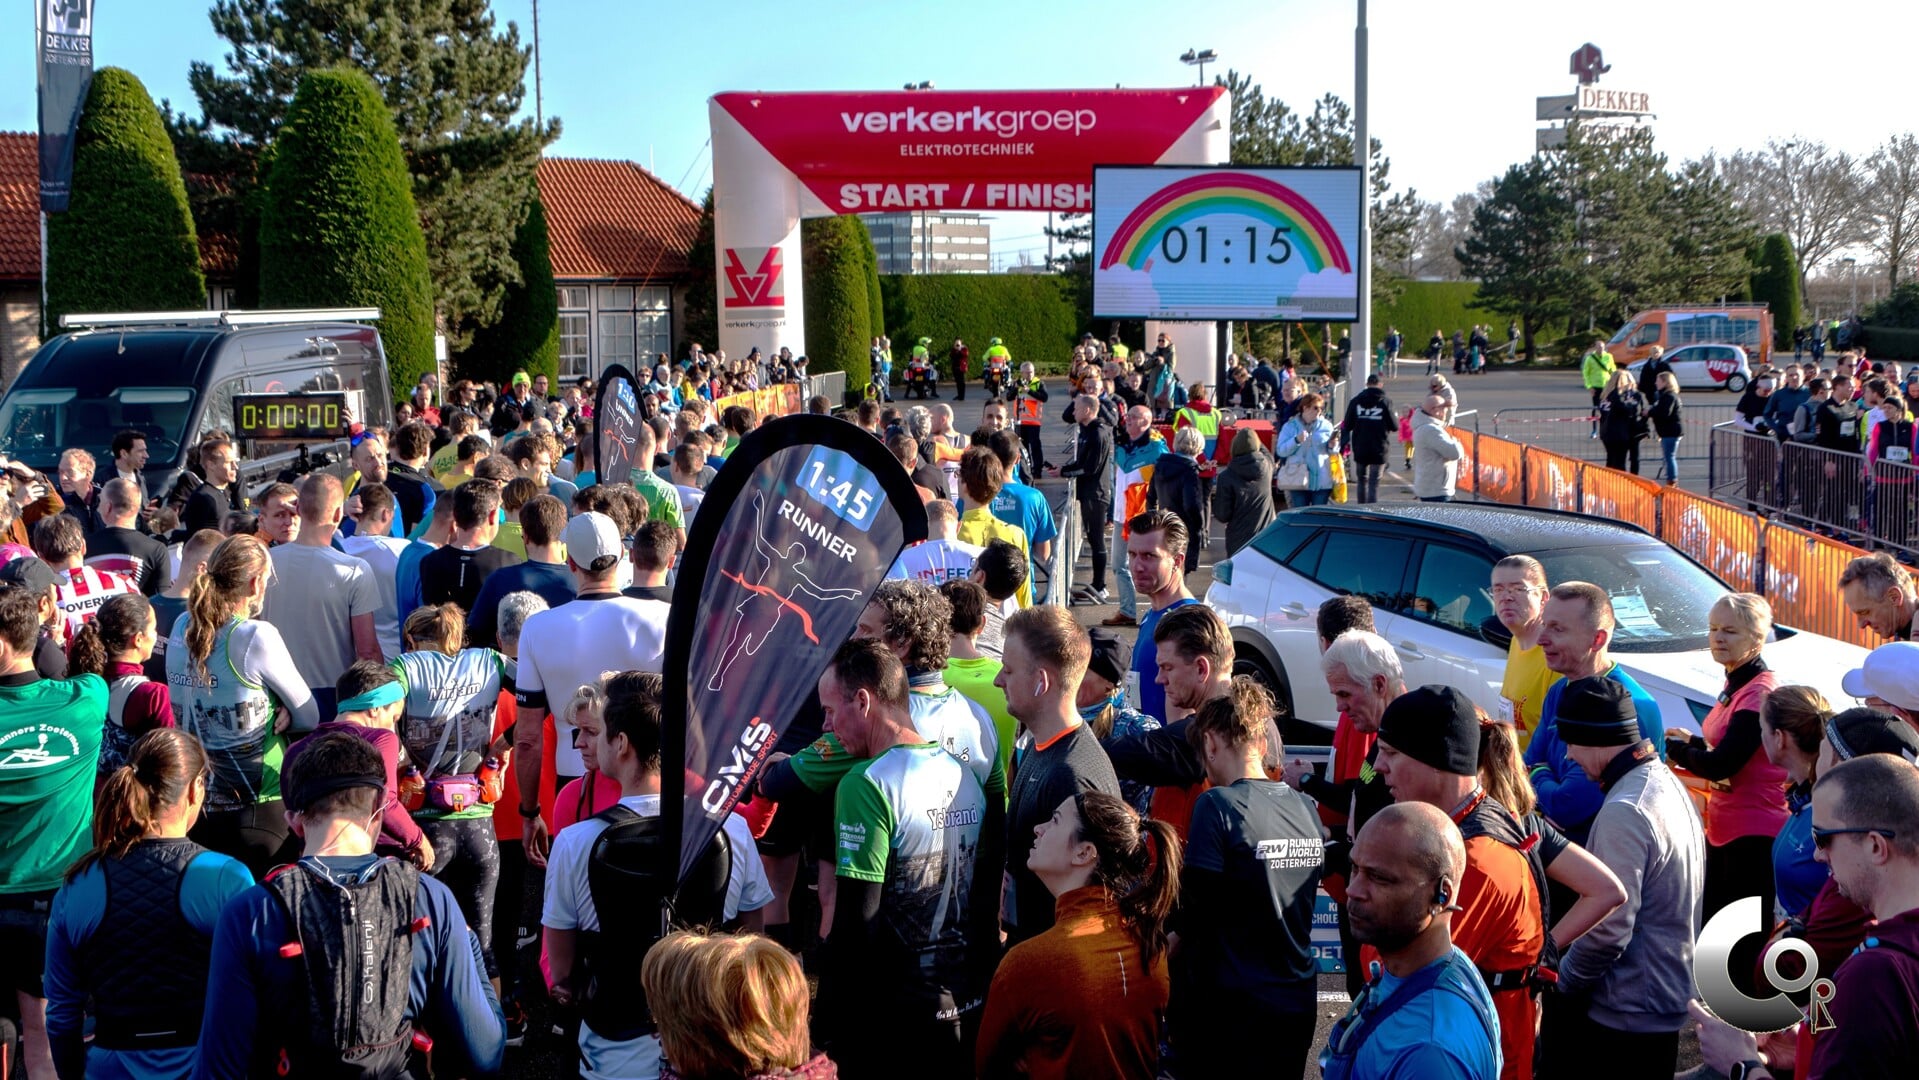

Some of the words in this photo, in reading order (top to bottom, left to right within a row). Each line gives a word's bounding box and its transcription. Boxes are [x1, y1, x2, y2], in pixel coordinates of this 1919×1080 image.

[1583, 88, 1649, 112] DEKKER
[840, 106, 1097, 138] verkerkgroep
[900, 143, 1035, 157] ELEKTROTECHNIEK
[840, 183, 950, 209] START
[961, 183, 975, 208] /
[1161, 225, 1292, 265] 01:15
[1708, 360, 1737, 374] JUST
[243, 404, 338, 429] 0:00:00
[808, 460, 874, 521] 1:45
[777, 499, 858, 563] RUNNER
[702, 722, 772, 814] CMS
[719, 784, 745, 818] CUSTOM
[740, 759, 760, 785] MADE
[757, 729, 778, 760] SPORT
[927, 803, 978, 831] Ysbrand
[1270, 858, 1322, 869] ZOETERMEER
[1289, 847, 1321, 858] WORLD
